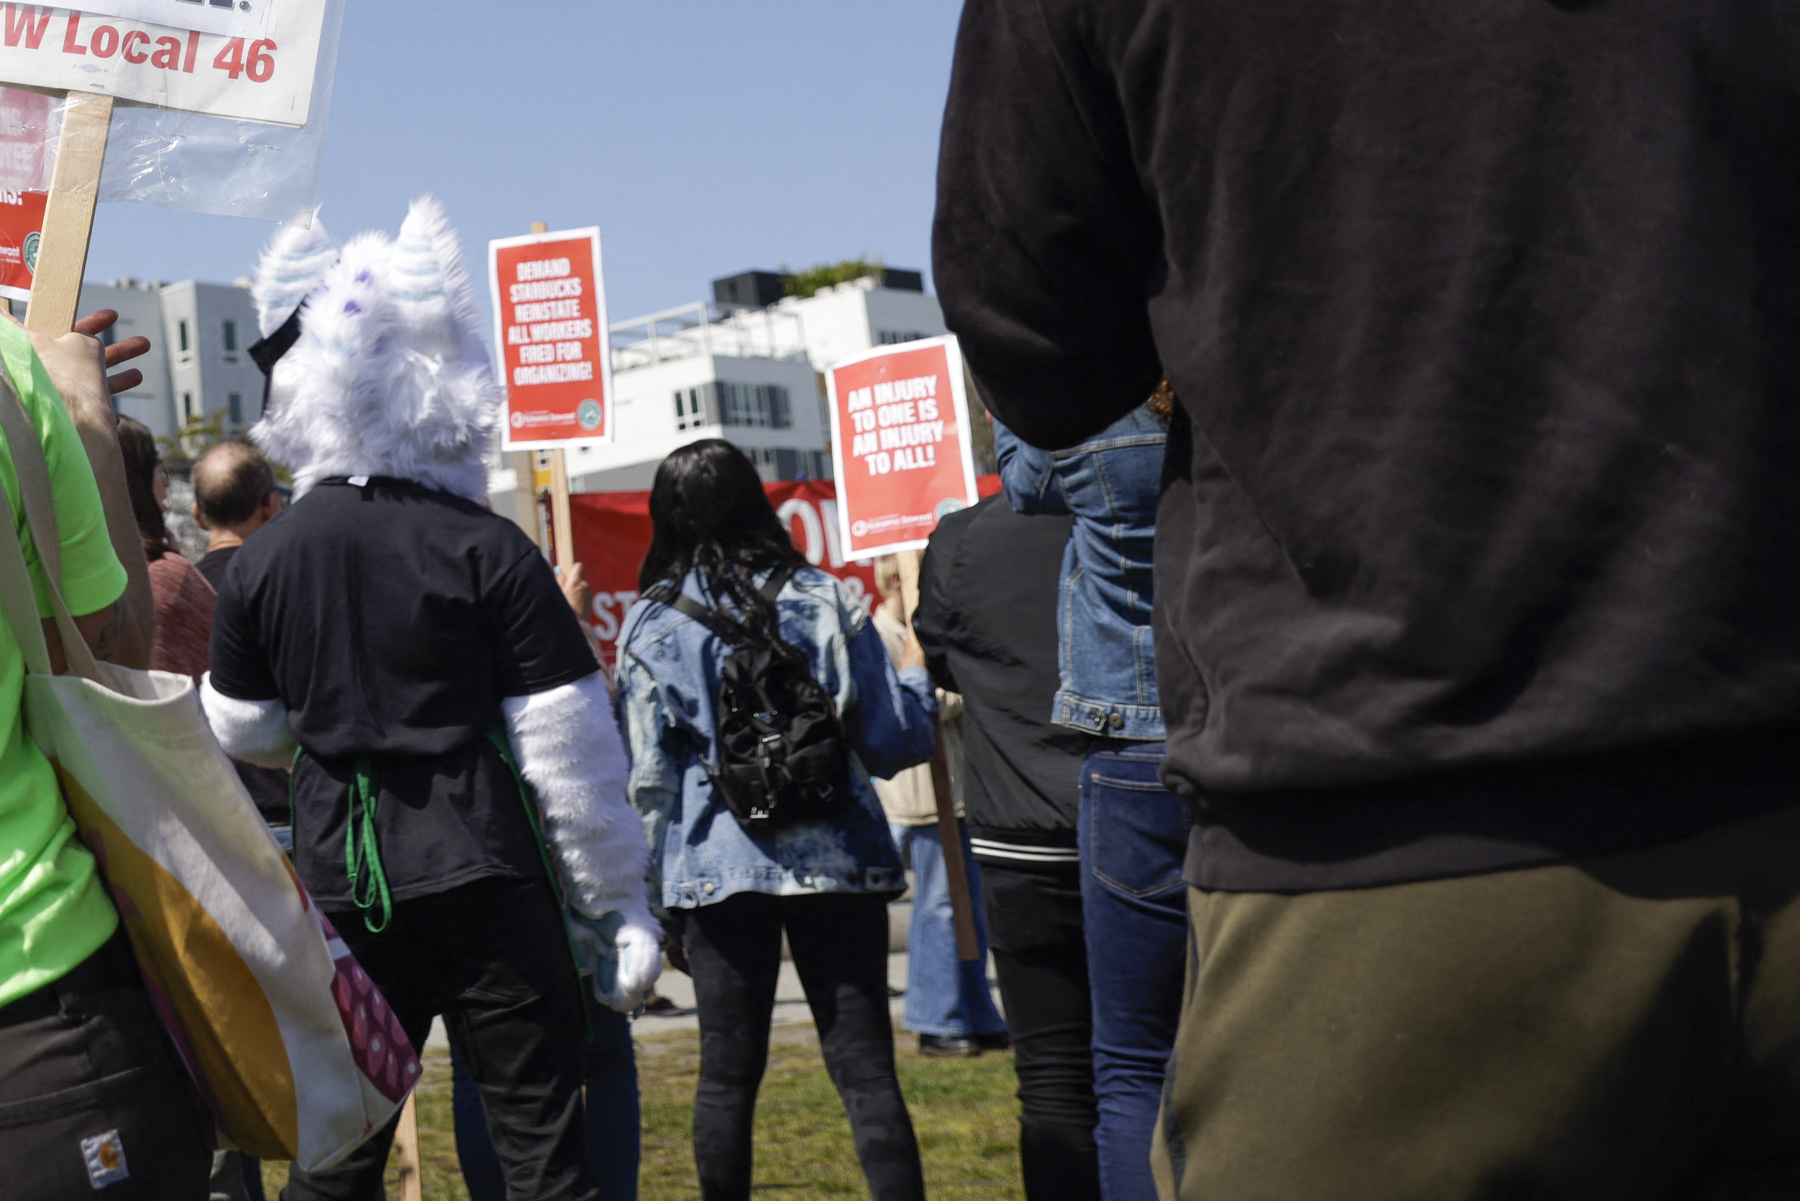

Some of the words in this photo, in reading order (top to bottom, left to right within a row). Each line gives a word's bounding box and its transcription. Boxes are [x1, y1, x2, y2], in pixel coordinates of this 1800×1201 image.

[63, 10, 198, 75] Local
[213, 35, 278, 84] 46
[516, 257, 571, 281] DEMAND
[509, 277, 583, 303] STARBUCKS
[514, 298, 581, 323] REINSTATE
[508, 325, 531, 345] ALL
[530, 318, 593, 343] WORKERS
[519, 343, 555, 365] FIRED
[556, 341, 583, 361] FOR
[513, 361, 593, 386] ORGANIZING!
[848, 386, 873, 413] AN
[873, 375, 938, 406] INJURY
[851, 409, 876, 433] TO
[877, 402, 917, 429] ONE
[918, 399, 939, 422] IS
[852, 431, 879, 457] AN
[880, 420, 944, 451] INJURY
[865, 451, 891, 477] TO
[893, 445, 936, 472] ALL!
